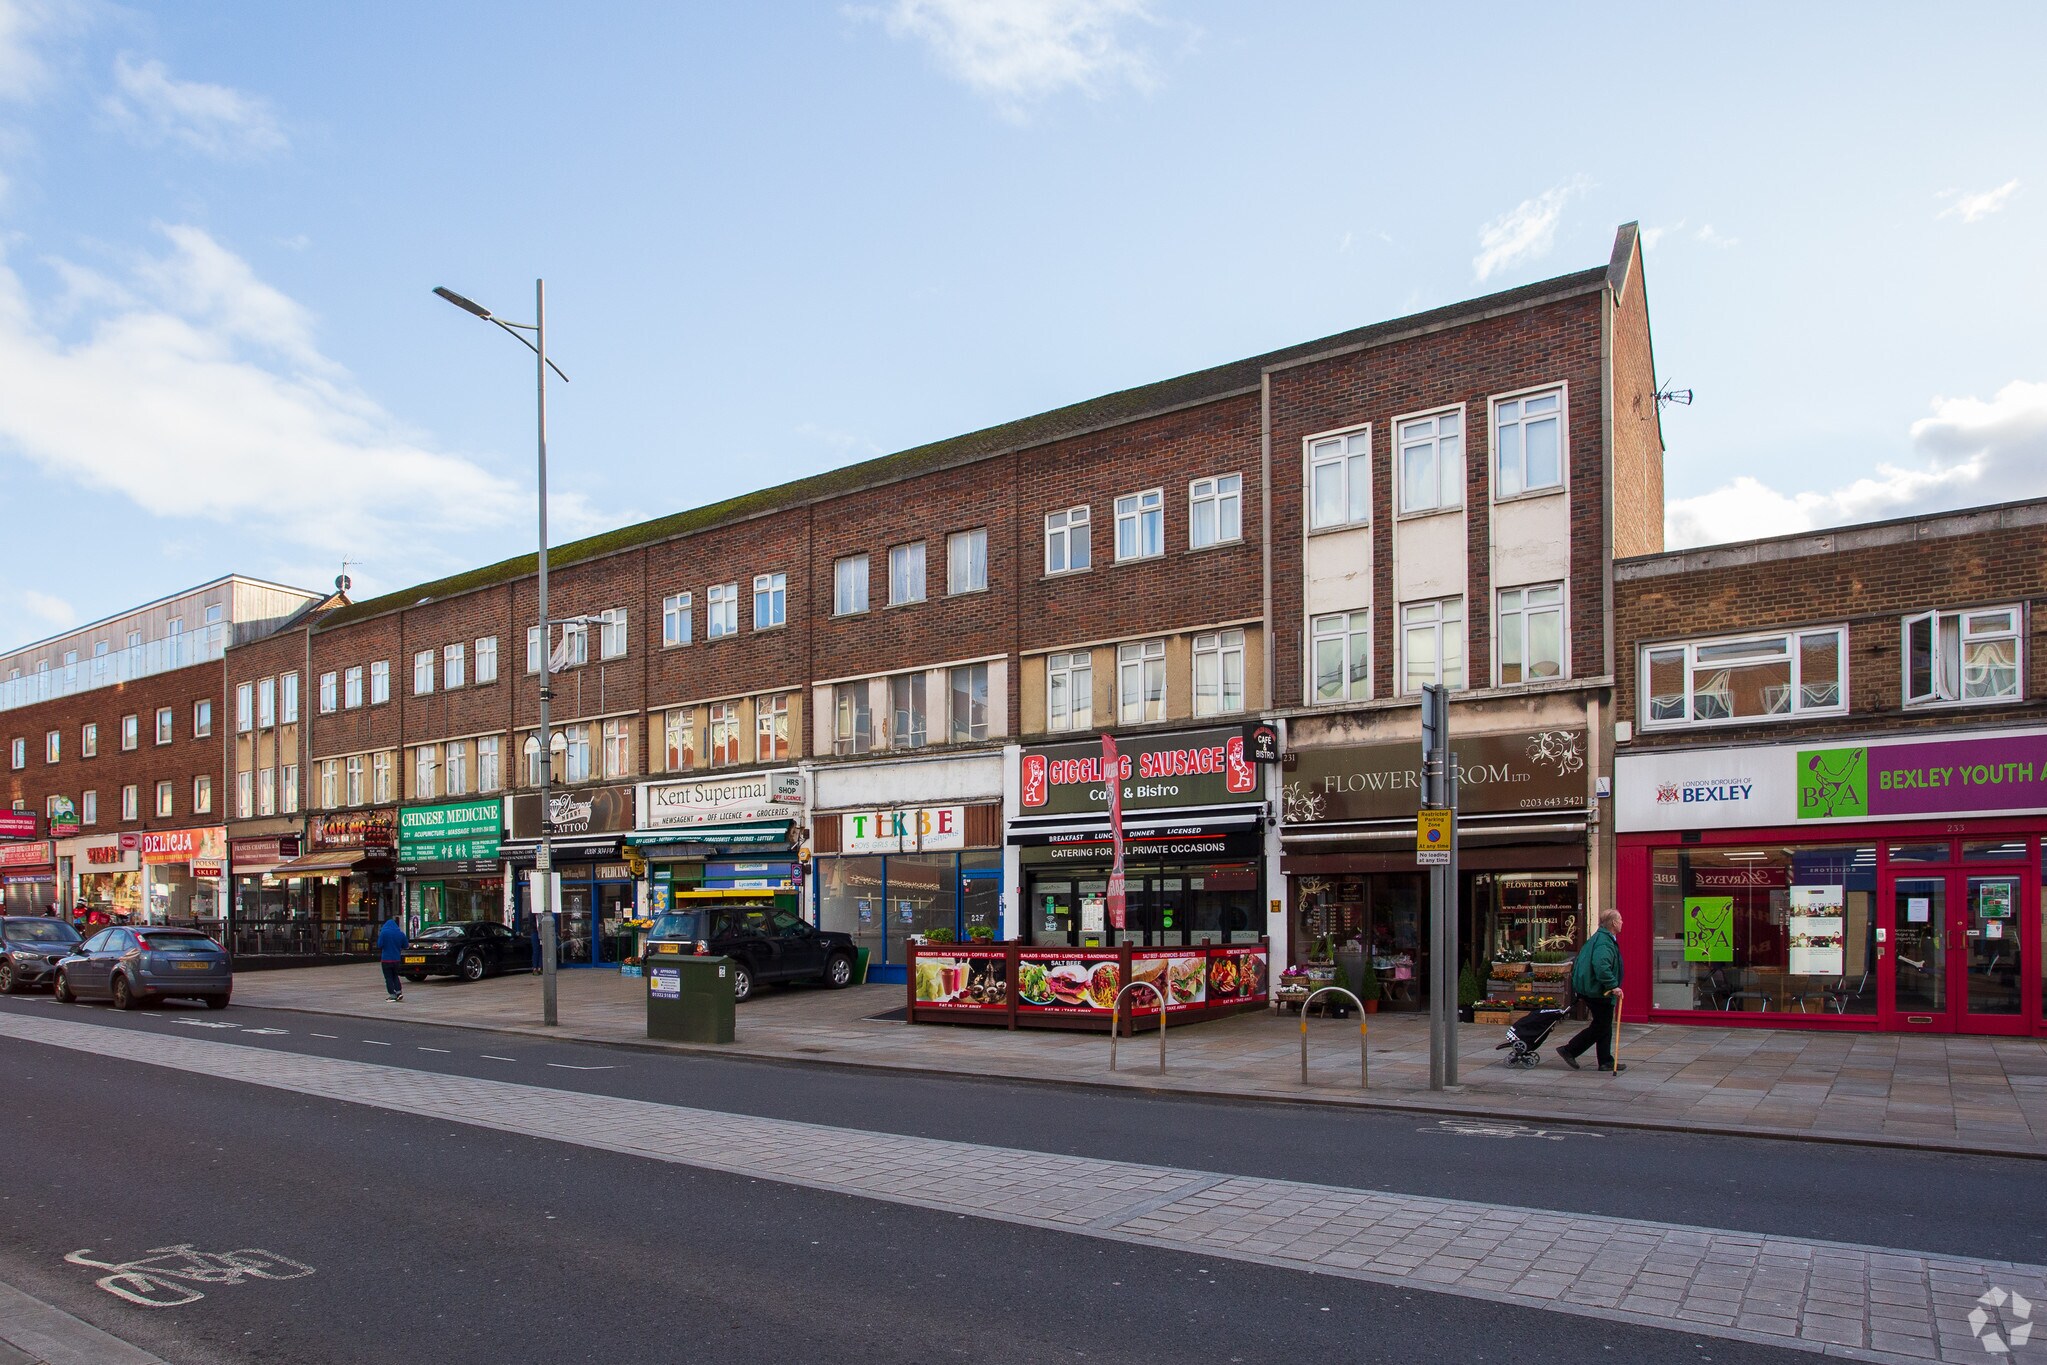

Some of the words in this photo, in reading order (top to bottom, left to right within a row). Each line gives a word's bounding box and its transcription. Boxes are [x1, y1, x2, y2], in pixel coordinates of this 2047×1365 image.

[1256, 750, 1275, 760] BISTRO
[1284, 754, 1296, 762] 231
[1049, 755, 1131, 786] GIGGLIG
[1139, 746, 1226, 779] SAUSAGE
[1324, 770, 1423, 793] FLOWER
[1457, 764, 1509, 785] ROM
[1511, 773, 1531, 783] LTD
[1711, 778, 1741, 786] BOROUGH
[1879, 766, 1953, 790] BEXLEY
[1959, 762, 2033, 785] YOUTH
[786, 778, 800, 787] HRS
[657, 786, 691, 807] Kent
[778, 786, 797, 795] SHOP
[1123, 787, 1134, 799] &
[1137, 783, 1179, 798] Bistro
[1682, 785, 1753, 803] BEXLEY
[1520, 798, 1542, 808] 0203
[1544, 797, 1561, 807] 643
[1563, 796, 1584, 806] 5421
[401, 810, 444, 827] CHINESE
[446, 805, 498, 823] MEDICINE
[662, 816, 694, 824] NEWSAGENT
[707, 813, 719, 821] OFF
[720, 812, 742, 821] LICENCE
[756, 808, 789, 818] GROCERIES
[414, 829, 445, 838] ACUPUNCTURE
[447, 827, 470, 835] MASSAGE
[1947, 824, 1965, 833] 233
[1048, 834, 1084, 843] BREAKFAST
[1094, 832, 1113, 840] LUNC
[1129, 829, 1156, 838] DINNER
[1166, 827, 1202, 835] LICENSED
[872, 841, 889, 849] GIRLS
[1051, 849, 1093, 858] CATERING
[1094, 848, 1113, 856] FOR
[1132, 845, 1169, 855] PRIVATE
[1170, 842, 1226, 853] OCCASIONS
[601, 865, 629, 878] PIERCING
[1505, 881, 1543, 889] FLOWERS
[1544, 880, 1569, 888] FROM
[971, 914, 985, 922] 227
